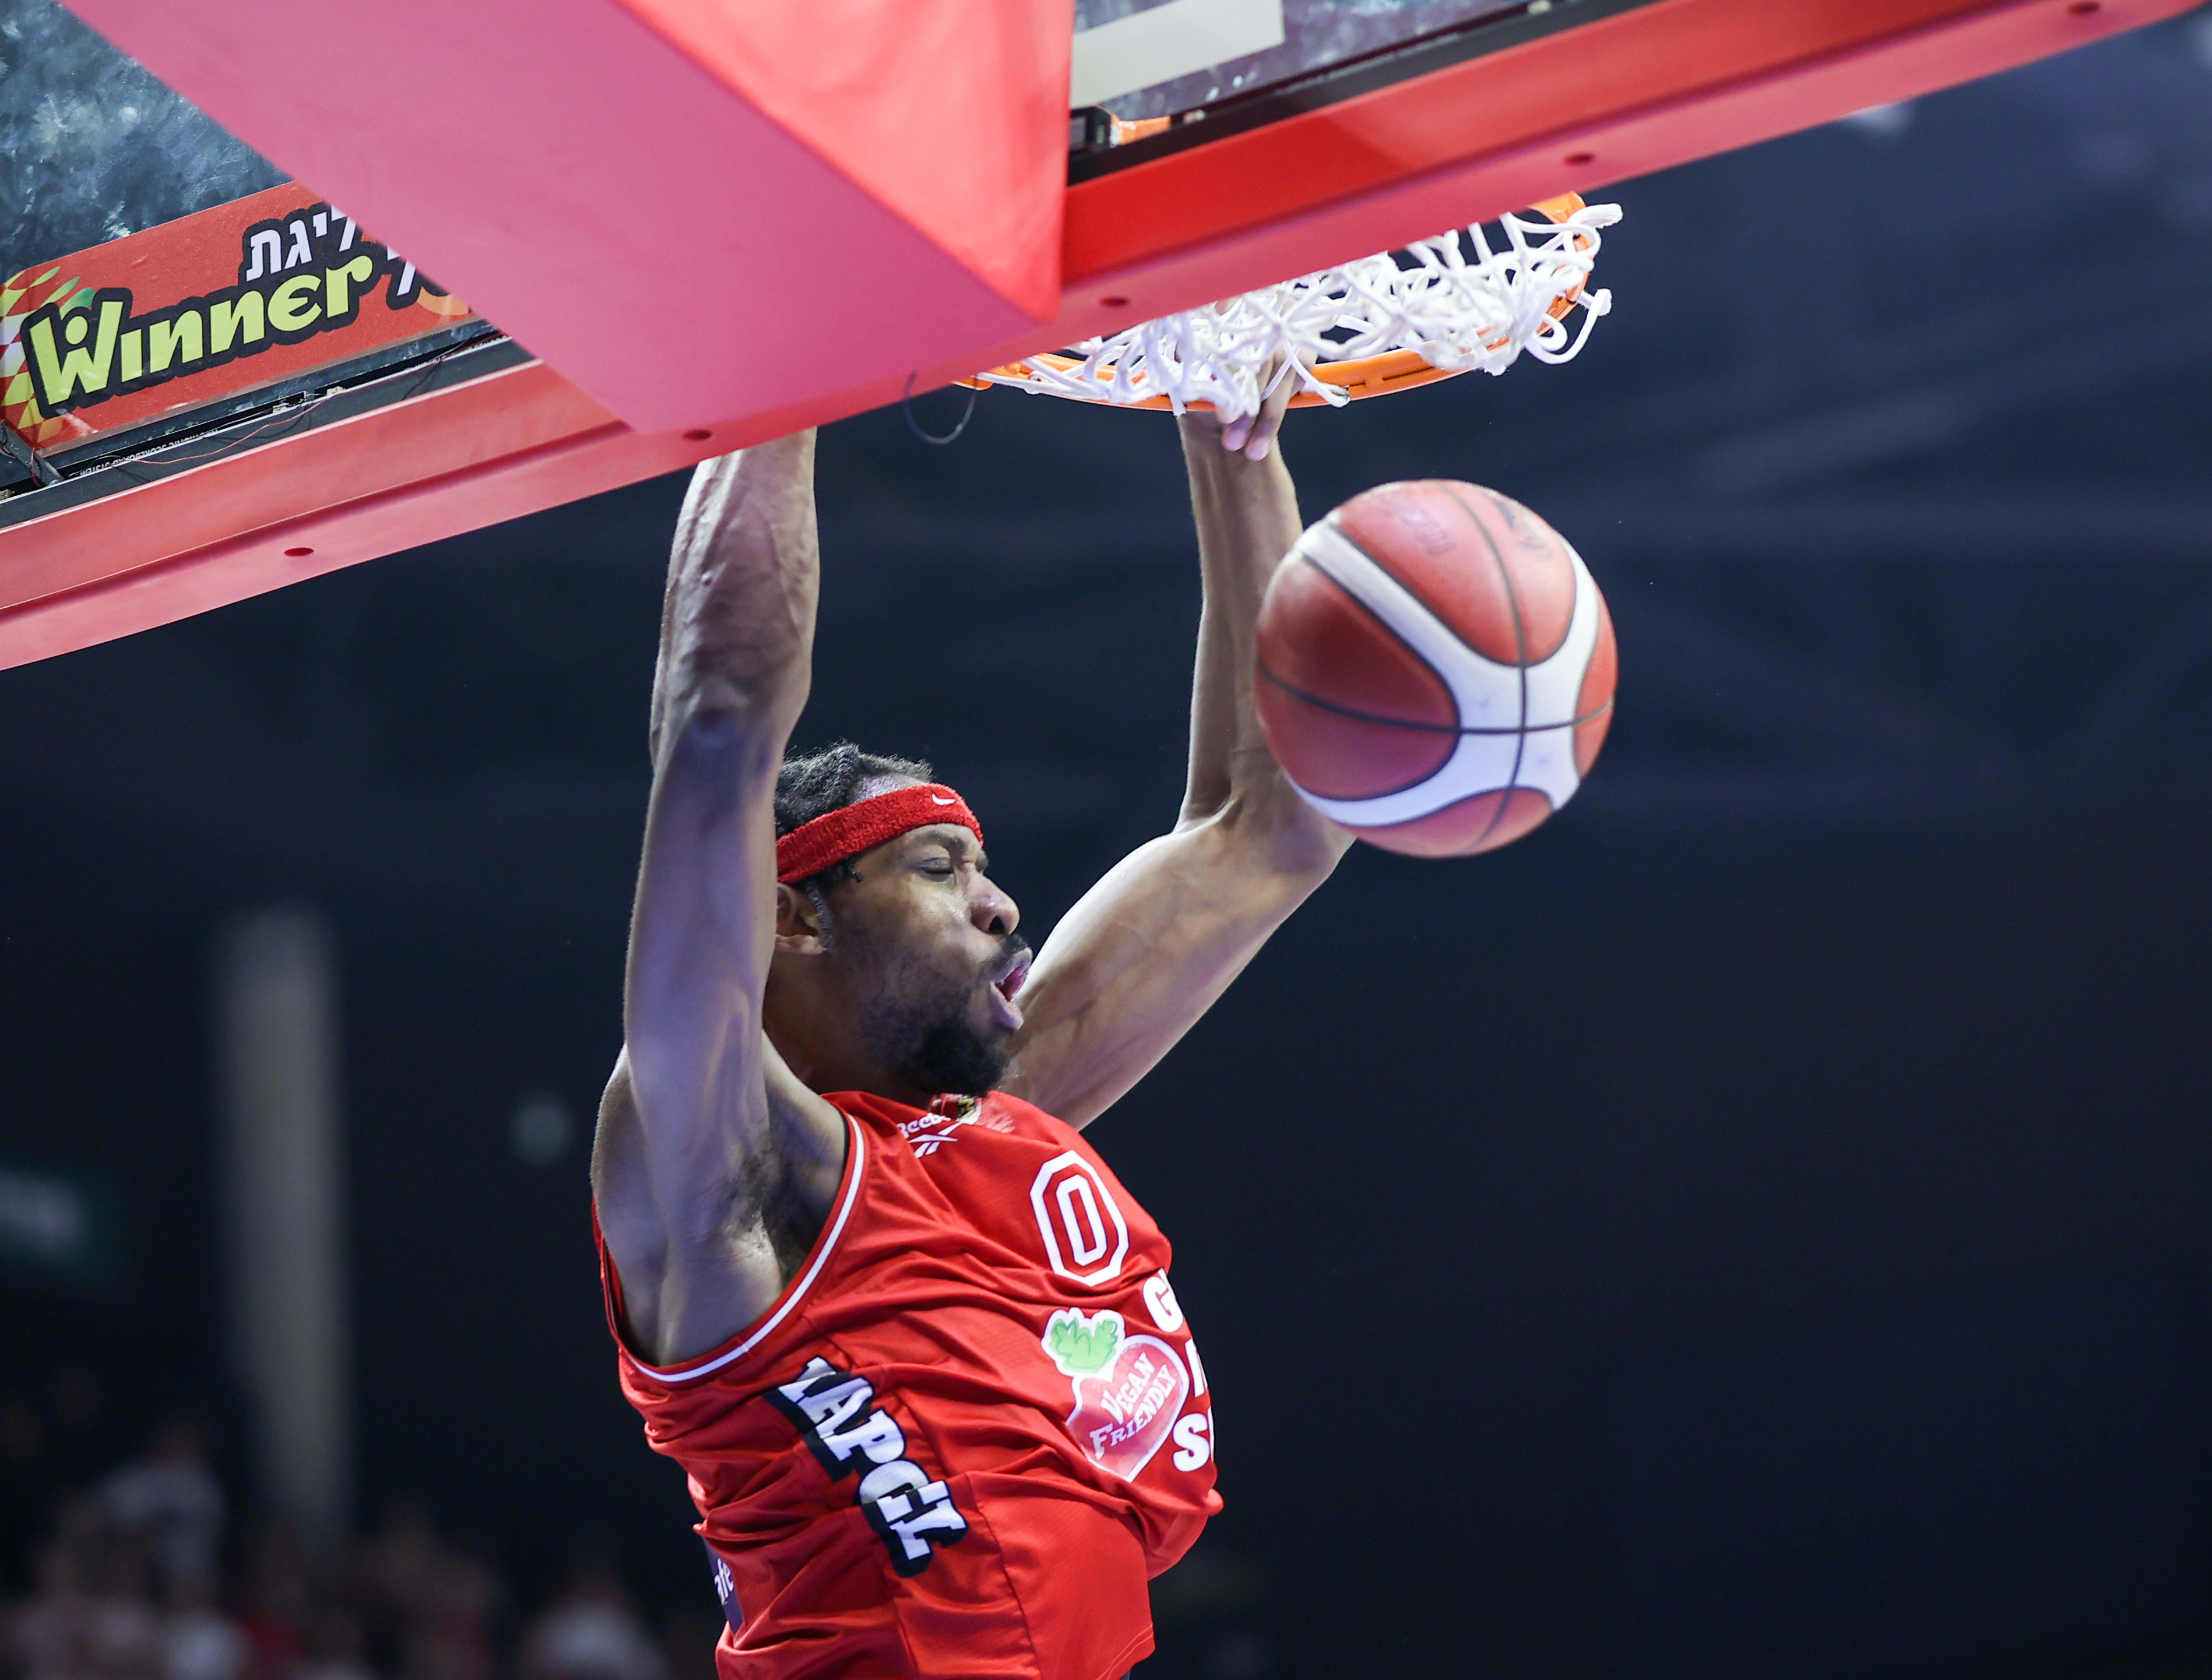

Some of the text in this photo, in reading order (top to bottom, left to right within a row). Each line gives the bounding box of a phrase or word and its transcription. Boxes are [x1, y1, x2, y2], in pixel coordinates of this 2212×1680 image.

[29, 255, 373, 405] Winner
[1029, 1150, 1129, 1287] 0
[1142, 1267, 1184, 1333] G
[1089, 1364, 1177, 1460] FRIENDLY
[1100, 1352, 1156, 1425] VEGAN
[1173, 1406, 1214, 1472] S
